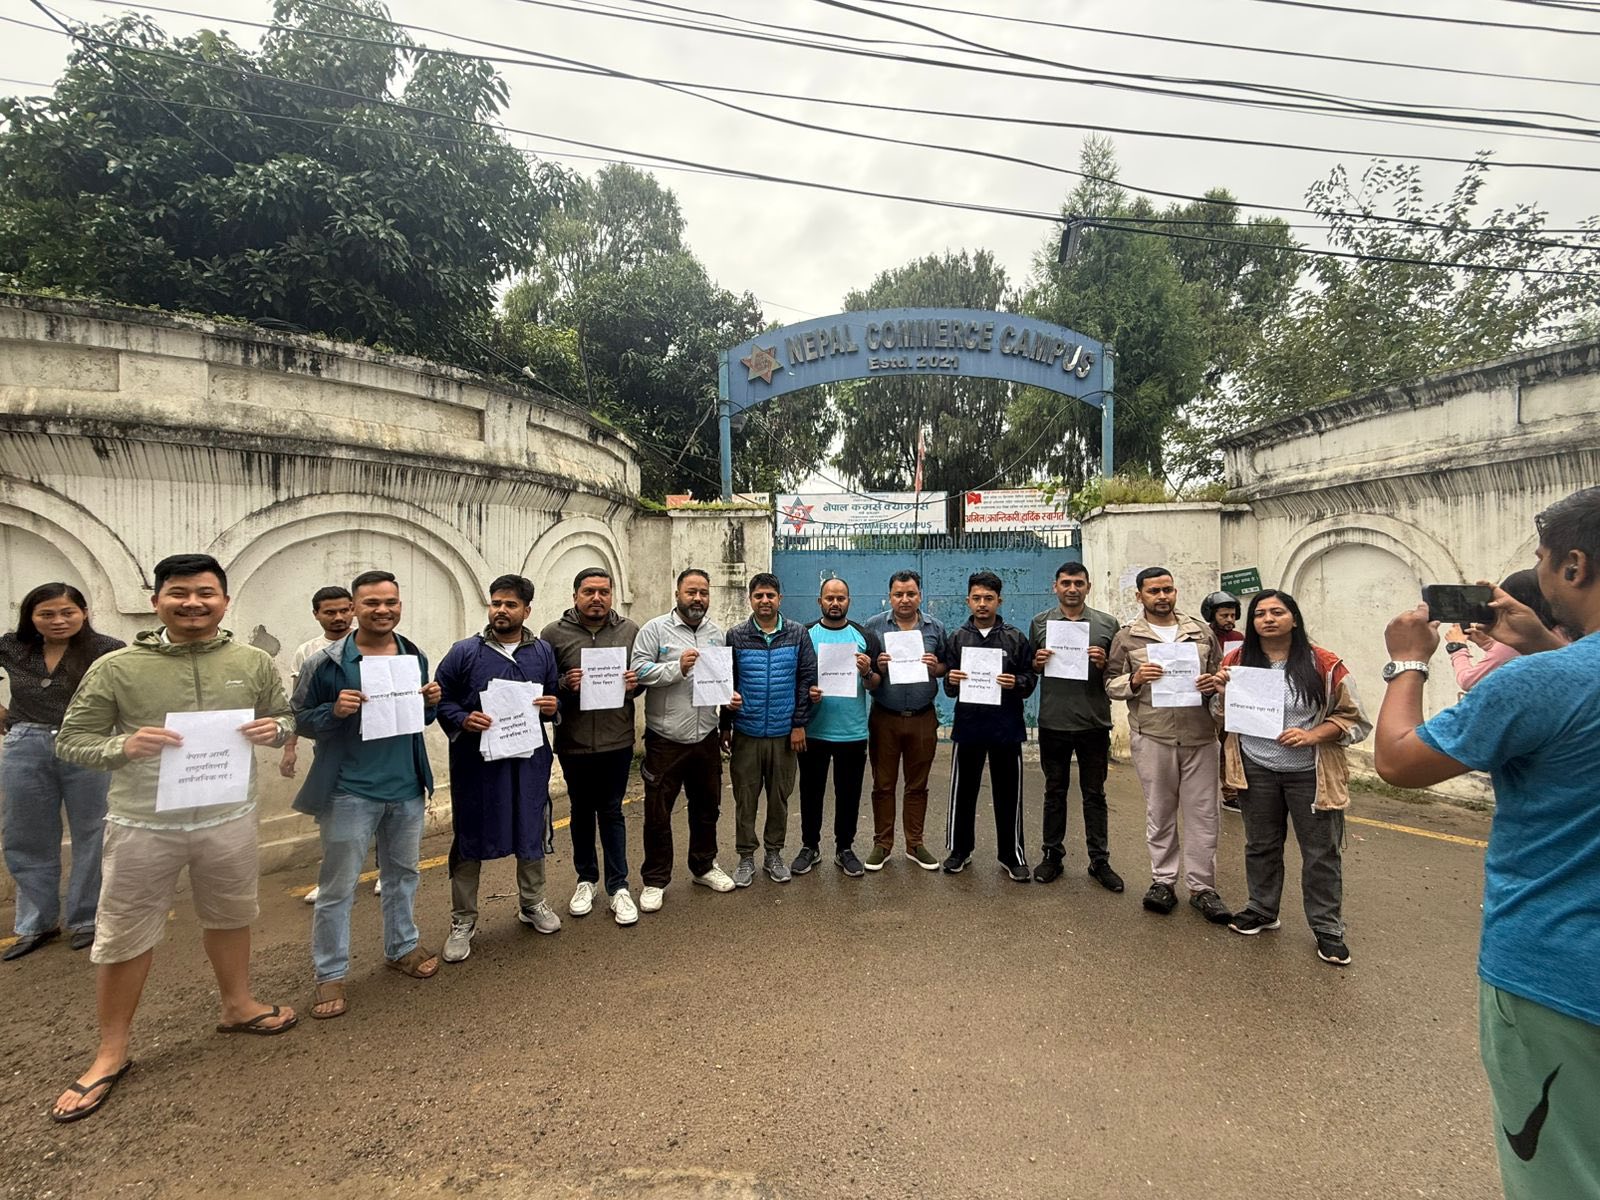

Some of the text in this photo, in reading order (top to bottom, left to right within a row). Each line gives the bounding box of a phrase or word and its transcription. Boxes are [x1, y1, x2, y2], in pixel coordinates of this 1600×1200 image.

[784, 319, 1096, 378] NEPAL COMMERCE CAMPUS
[868, 355, 959, 371] Estd. 2021
[823, 502, 849, 511] नेपाल
[851, 501, 882, 511] कमर्स
[1042, 511, 1064, 521] स्वागत
[823, 521, 932, 530] NEPAL COMMERCE CAMPUS
